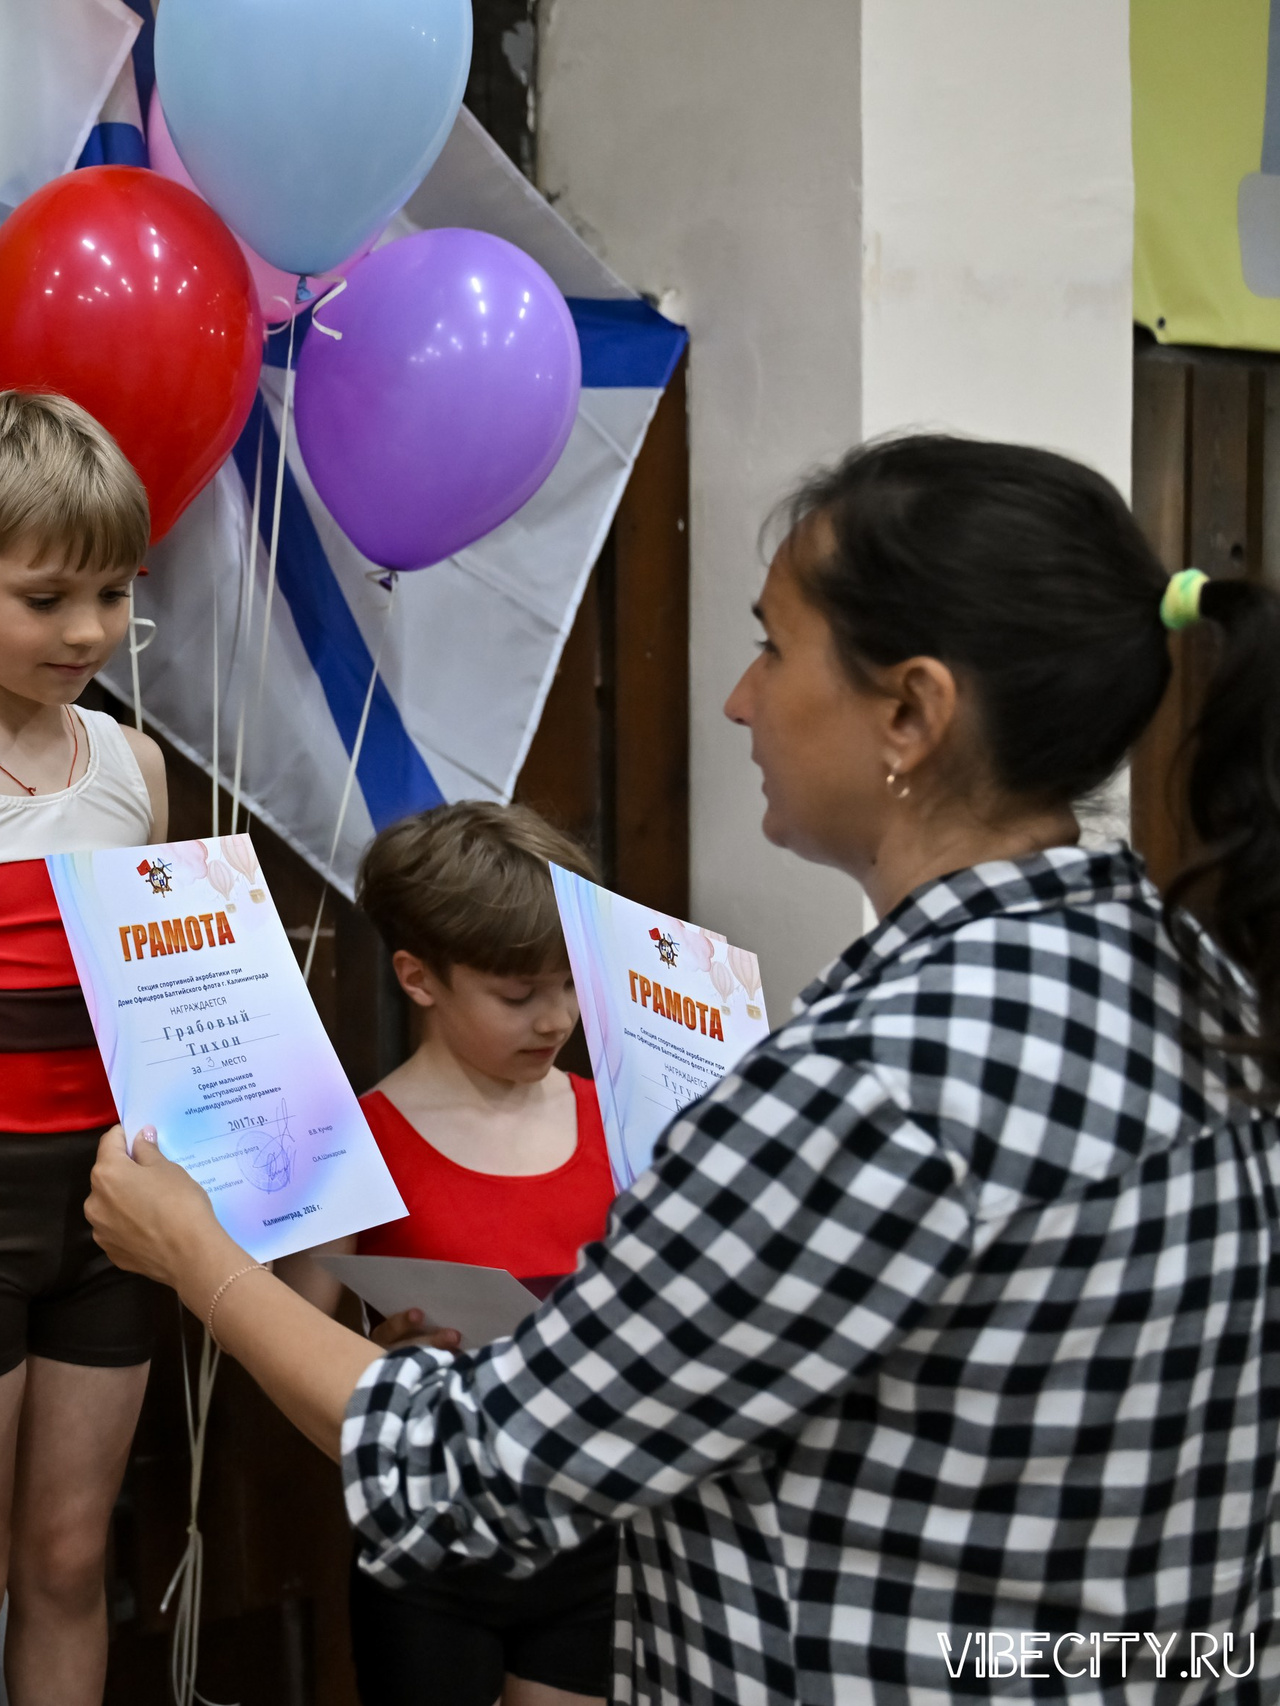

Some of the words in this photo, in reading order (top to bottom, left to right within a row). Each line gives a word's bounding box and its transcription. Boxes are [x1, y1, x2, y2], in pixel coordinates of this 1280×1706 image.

[119, 910, 236, 962] ГРАМОТА
[117, 997, 133, 1008] Доме
[133, 992, 164, 1006] Офицеров
[164, 985, 202, 999] Балтийского
[202, 980, 222, 992] флота
[226, 971, 269, 987] Калининграда
[137, 981, 159, 992] Секция
[159, 975, 195, 990] спортивной
[195, 970, 230, 984] акробатики
[230, 967, 242, 977] при
[170, 996, 228, 1015] НАГРАЖДАЕТСЯ
[628, 969, 724, 1042] ГРАМОТА
[162, 1009, 250, 1042] Грабовый
[185, 1035, 241, 1056] Тихон
[636, 1034, 661, 1052] Офицеров
[660, 1046, 691, 1066] Балтийского
[640, 1026, 657, 1041] Секция
[657, 1035, 686, 1055] спортивной
[685, 1050, 715, 1067] акробатики
[714, 1062, 726, 1071] при
[191, 1065, 202, 1075] за
[205, 1056, 215, 1068] 3
[221, 1054, 247, 1068] место
[664, 1062, 709, 1091] НАГРАЖДАЕТСЯ
[197, 1081, 218, 1092] Среди
[219, 1072, 254, 1086] мальчиков
[202, 1084, 247, 1100] выступающих
[248, 1081, 257, 1089] по
[184, 1095, 244, 1116] «Индивидуальной
[243, 1086, 282, 1101] программе»
[211, 1150, 244, 1163] Балтийского
[243, 1145, 260, 1155] флота
[199, 1177, 217, 1186] екции
